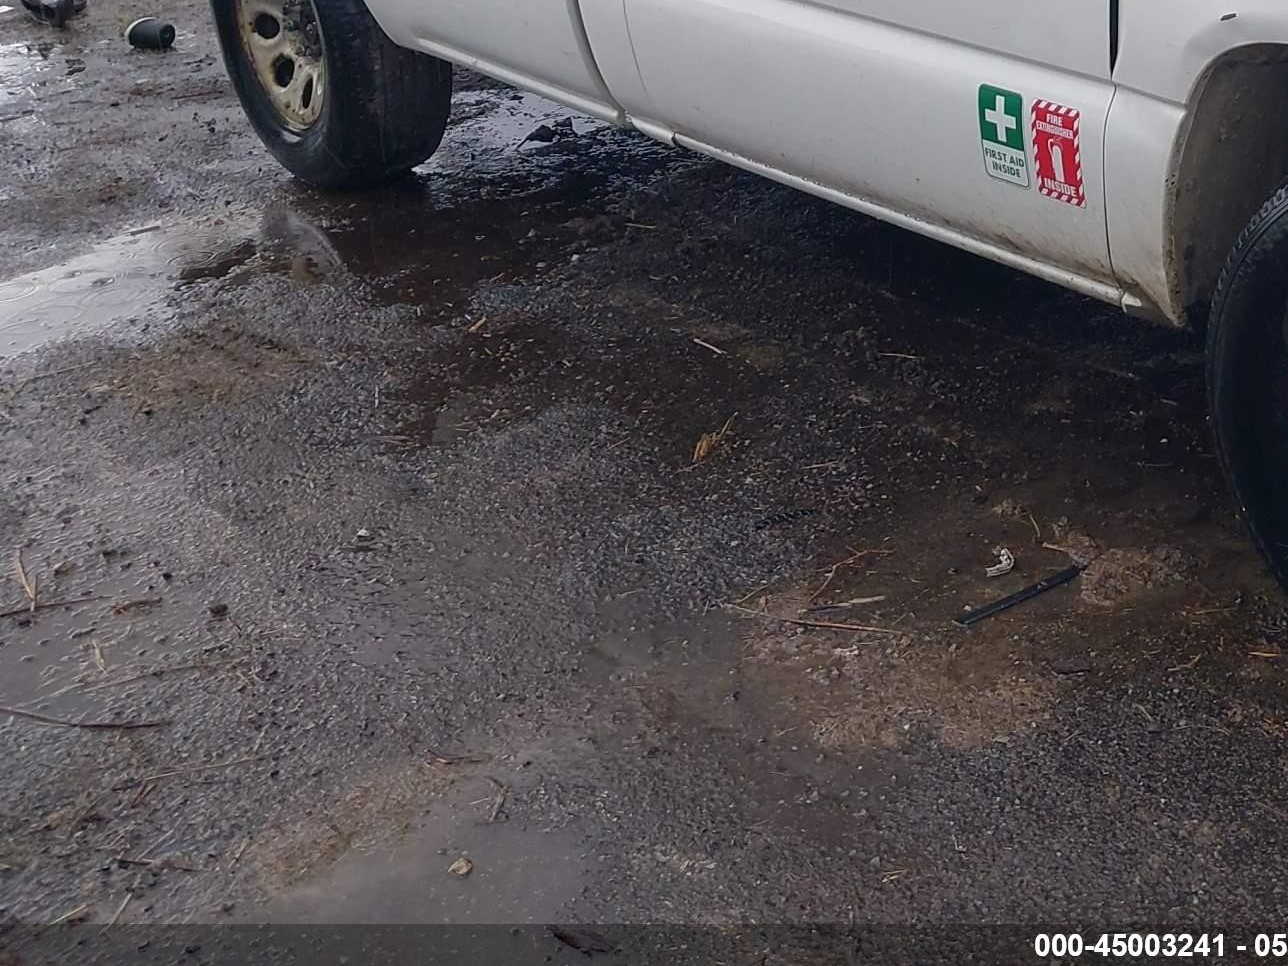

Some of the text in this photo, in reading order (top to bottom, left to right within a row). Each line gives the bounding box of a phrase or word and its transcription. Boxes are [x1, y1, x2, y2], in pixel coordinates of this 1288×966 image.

[1046, 113, 1063, 127] FIRE
[985, 147, 1025, 168] FIRST AID
[992, 161, 1022, 179] INSIDE
[1043, 177, 1078, 197] INSIDE
